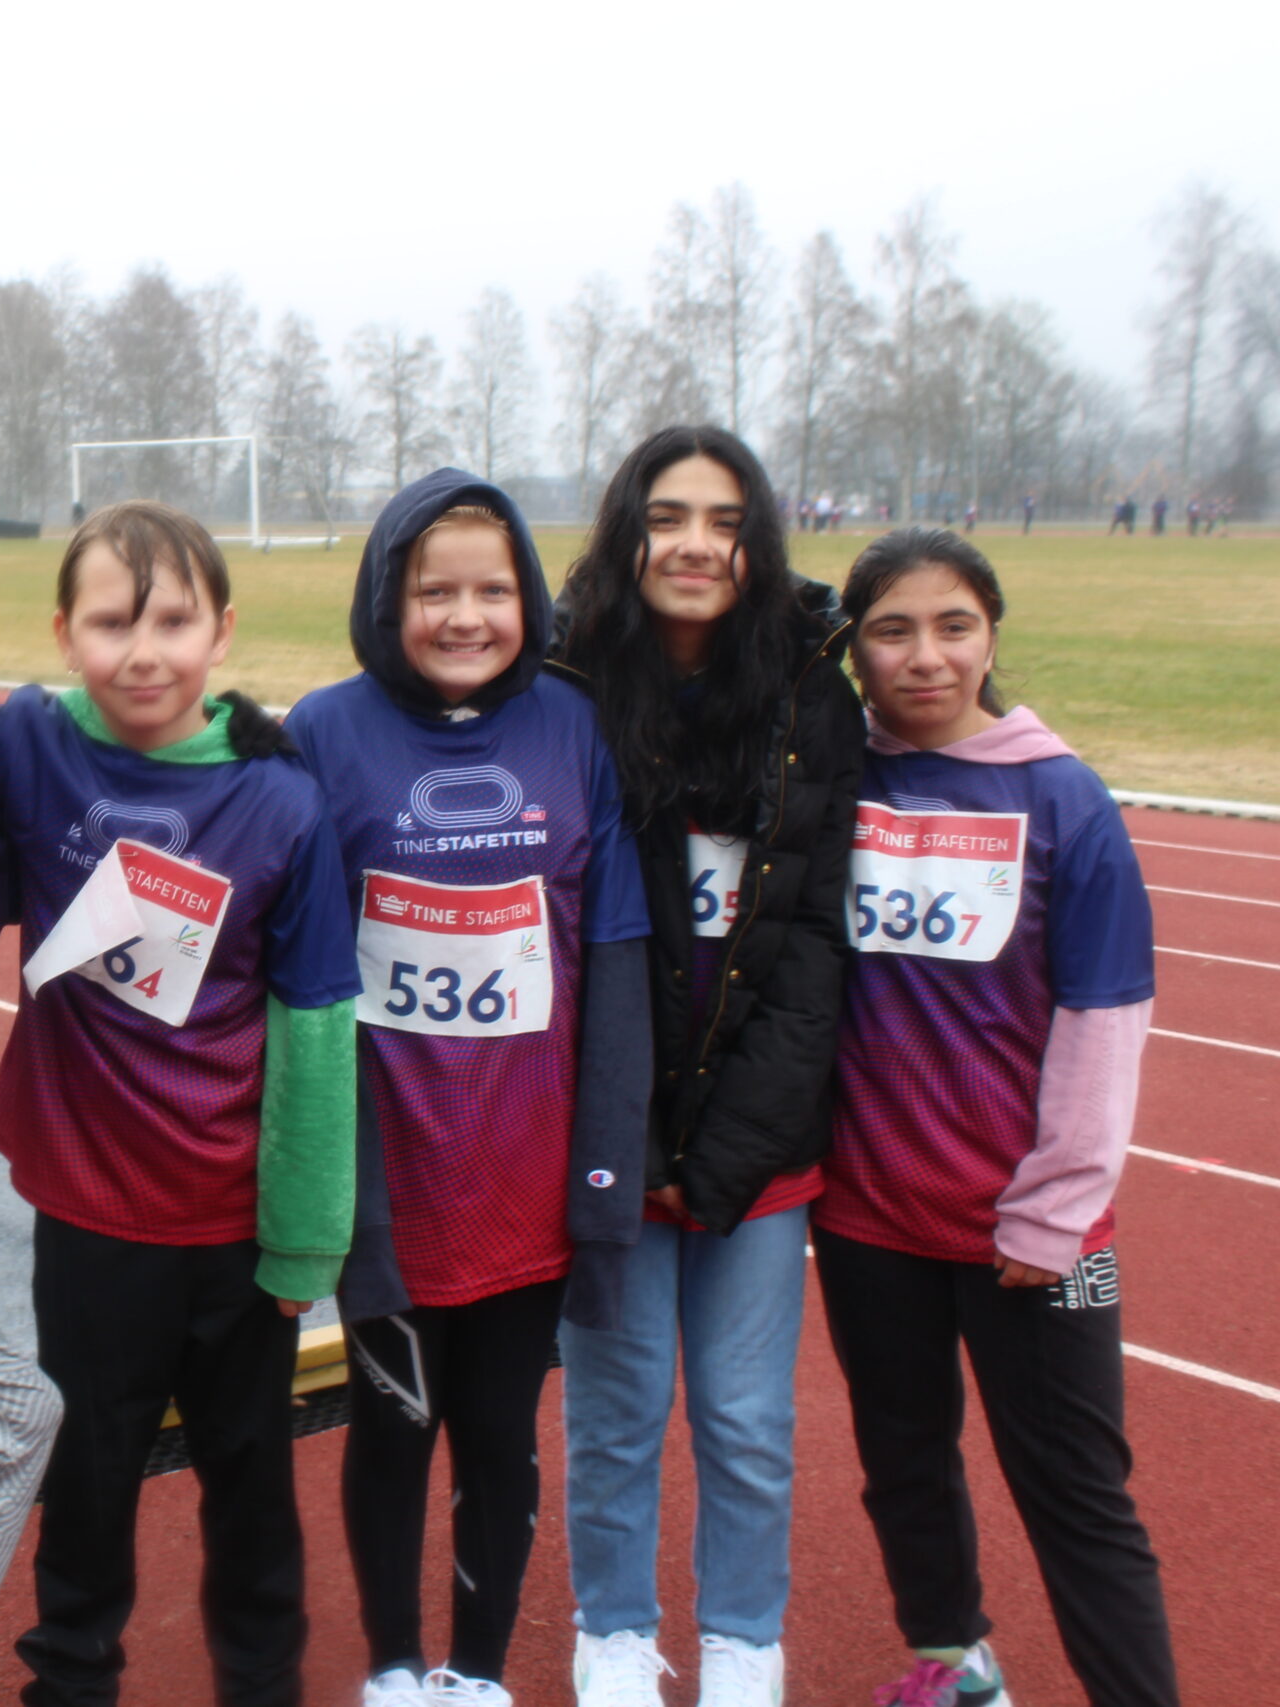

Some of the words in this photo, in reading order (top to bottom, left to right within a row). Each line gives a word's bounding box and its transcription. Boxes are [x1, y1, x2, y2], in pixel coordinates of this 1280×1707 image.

[875, 827, 916, 849] TINE
[922, 833, 1009, 852] STAFETTEN
[126, 866, 211, 913] STAFETTEN
[412, 904, 458, 925] TINE
[465, 902, 532, 926] STAFETTEN
